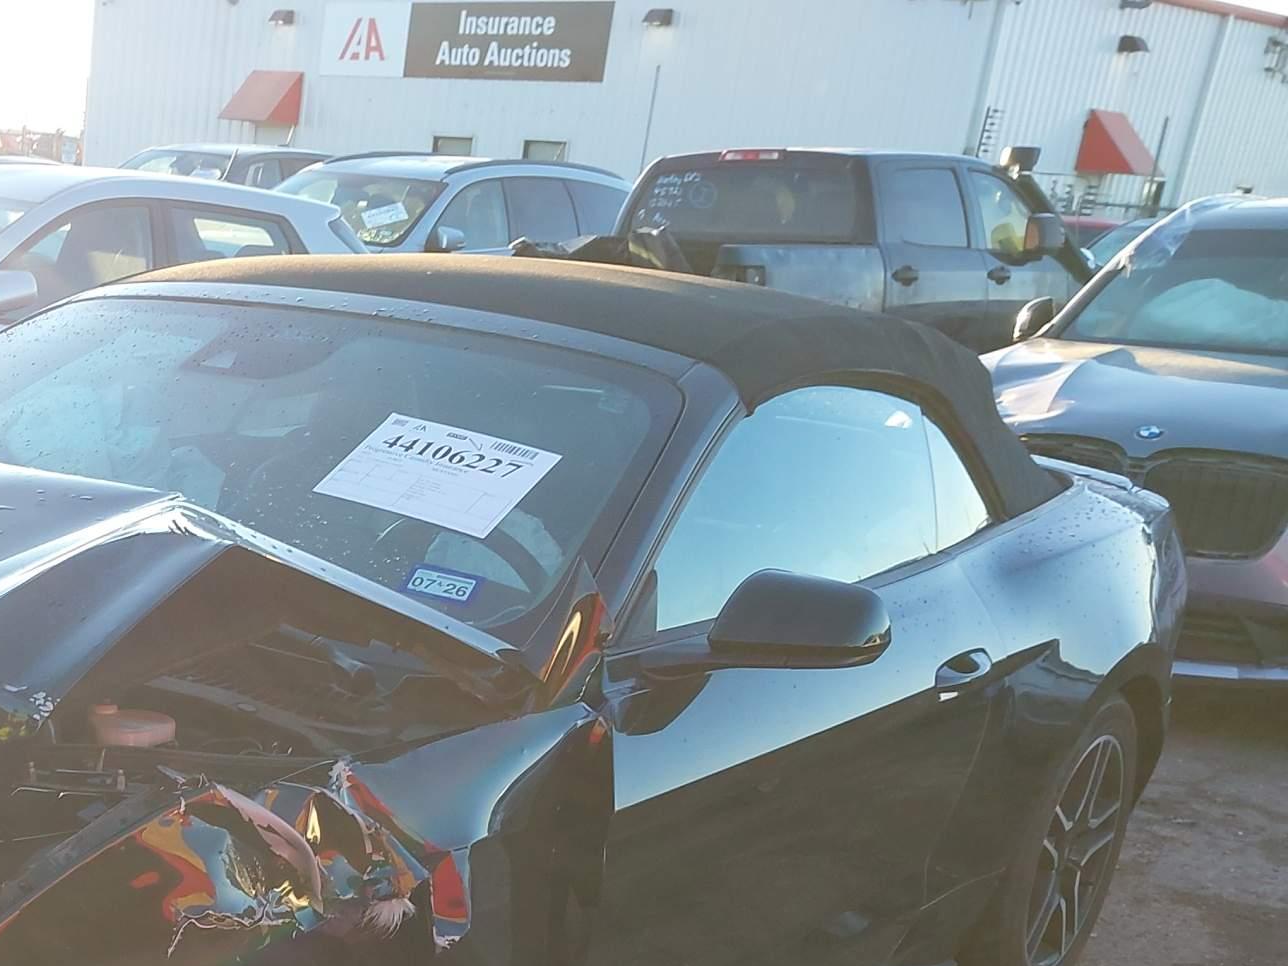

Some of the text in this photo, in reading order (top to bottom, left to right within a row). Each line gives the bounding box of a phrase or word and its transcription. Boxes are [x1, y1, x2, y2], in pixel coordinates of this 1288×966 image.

[458, 10, 556, 35] Insurance
[436, 41, 571, 68] Auto Auctions
[383, 434, 524, 478] 44106227
[412, 576, 468, 597] 07 26
